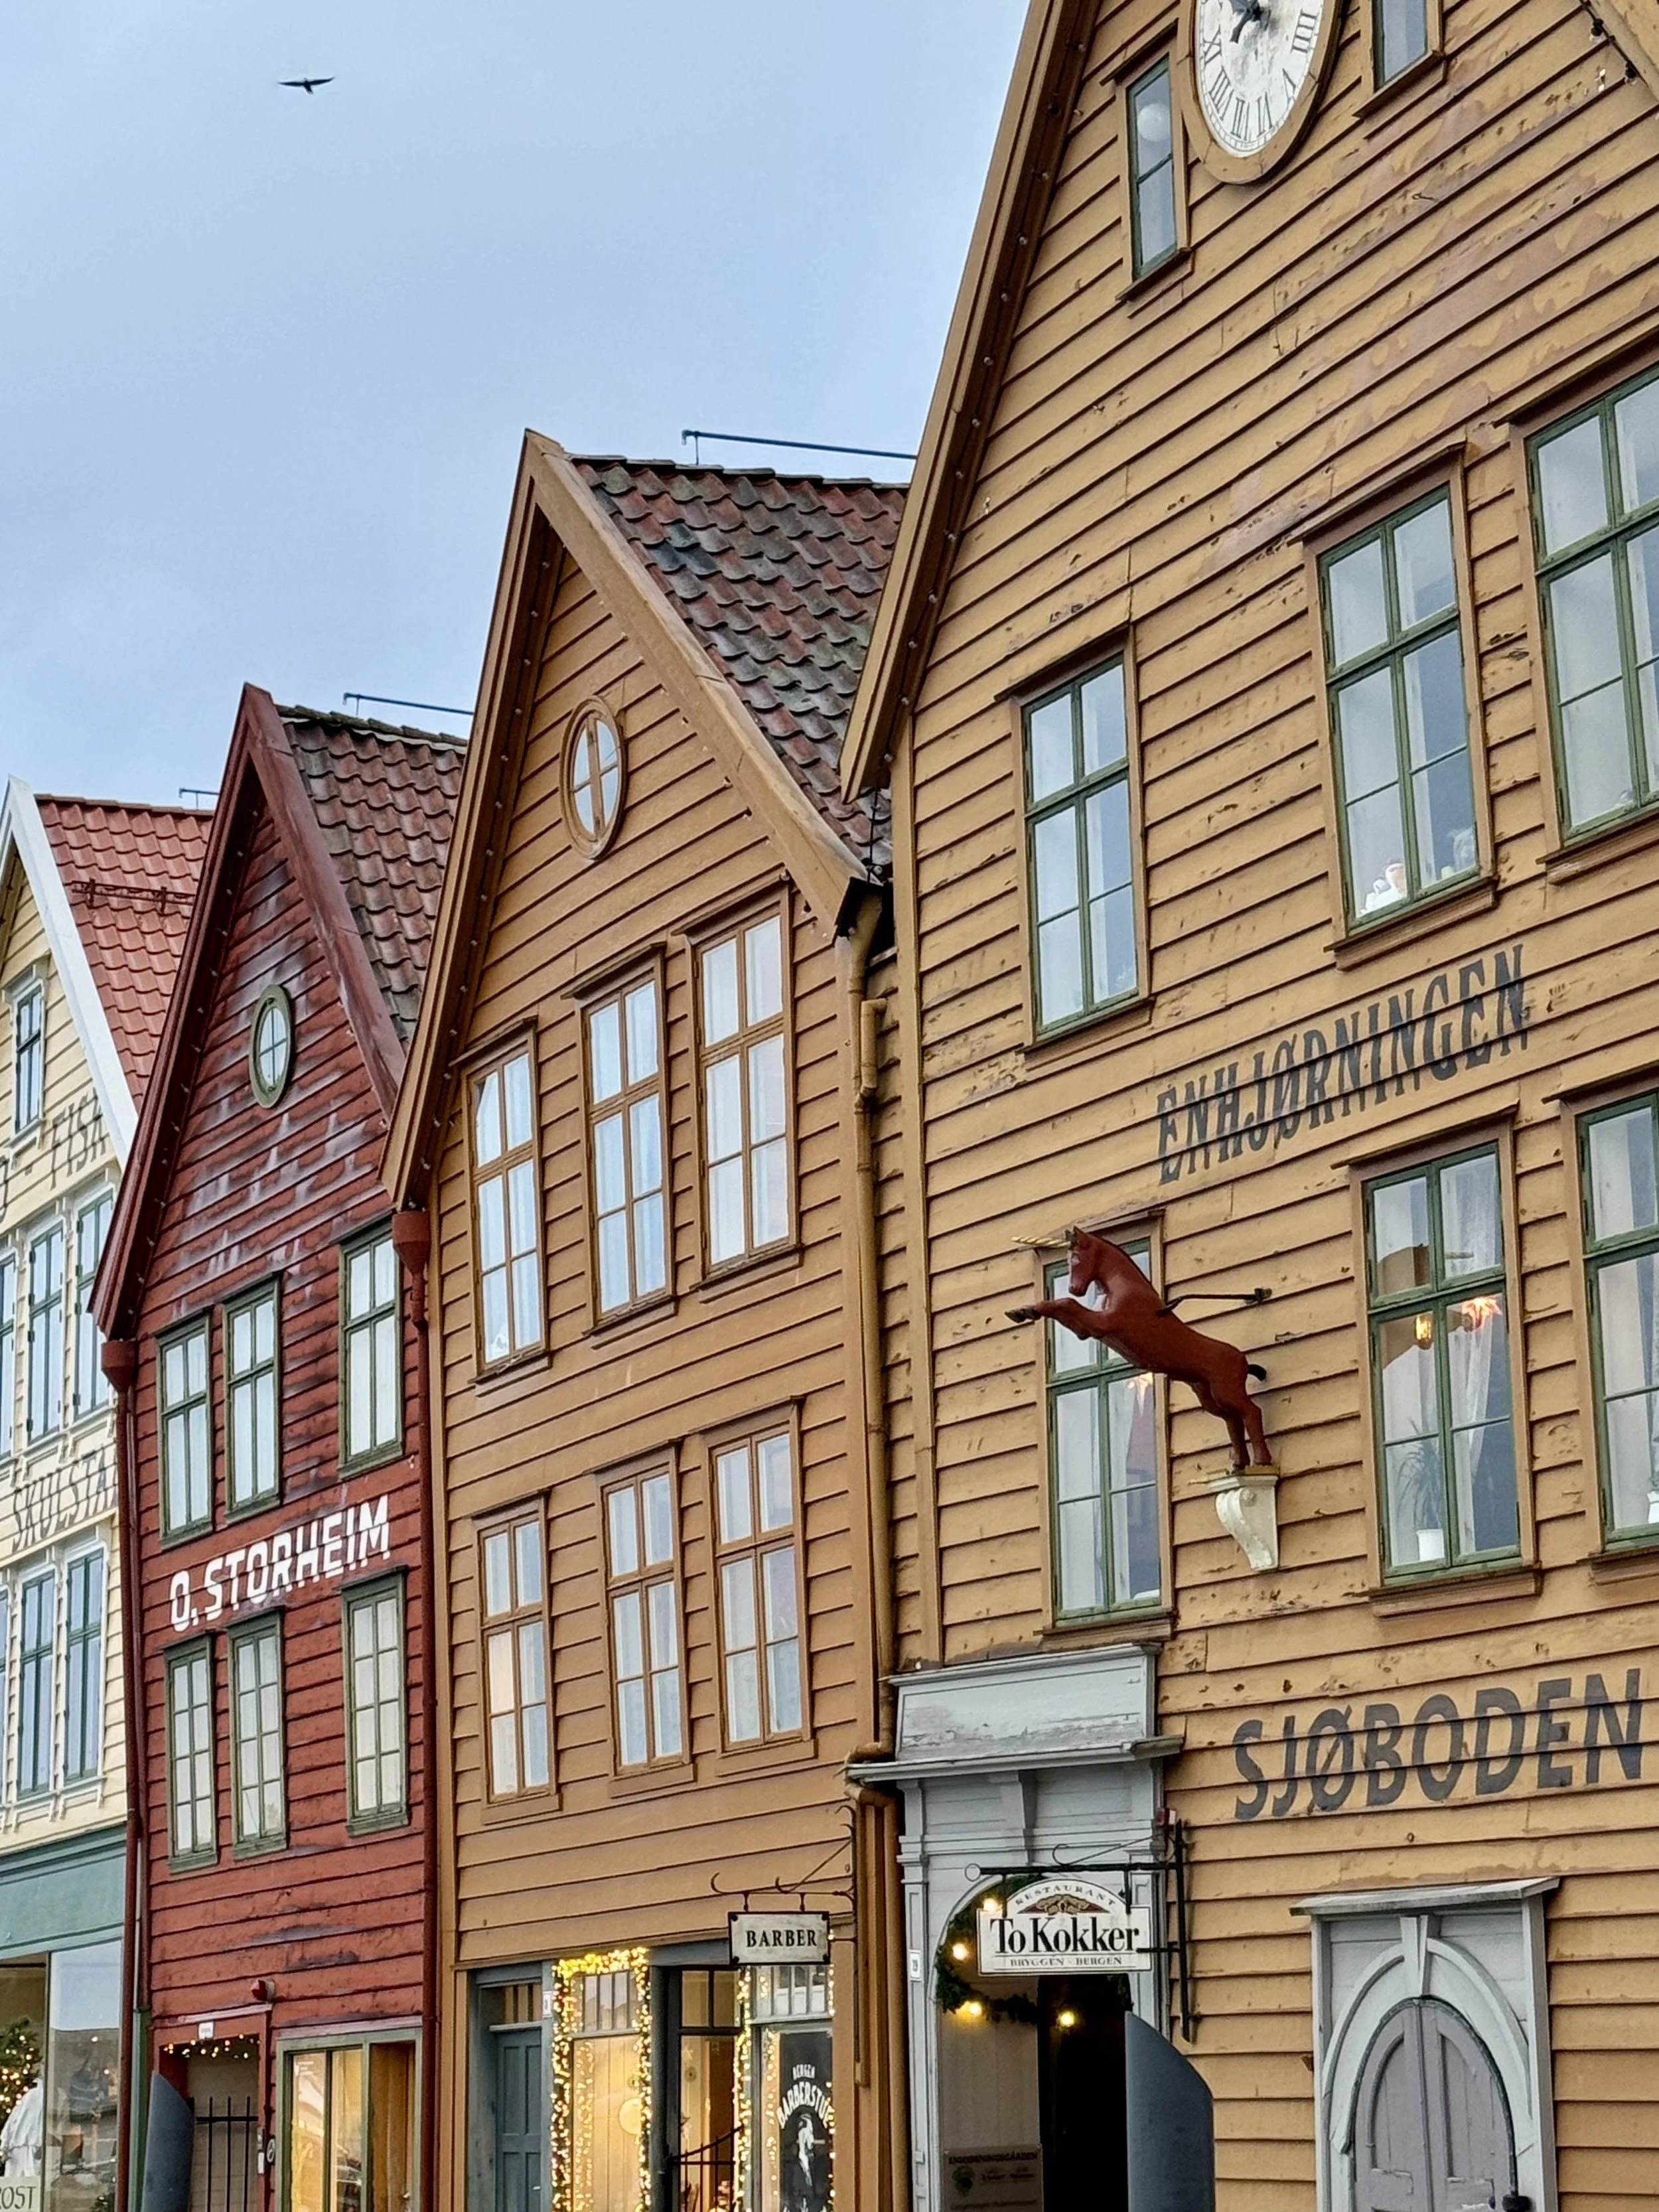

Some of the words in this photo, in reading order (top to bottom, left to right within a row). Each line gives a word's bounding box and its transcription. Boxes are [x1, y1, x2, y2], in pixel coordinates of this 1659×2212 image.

[1156, 944, 1528, 1185] ENHJØRNINGEN
[12, 1441, 118, 1554] SKULSTA
[1232, 1668, 1642, 1821] SJØBODEN
[1015, 1884, 1116, 1906] RESTAURANT
[746, 1929, 817, 1947] BARBER
[989, 1918, 1026, 1953] To
[1029, 1917, 1139, 1953] Kokker
[1010, 1958, 1064, 1966] BRYGGEN
[1076, 1956, 1122, 1965] BERGEN
[0, 2185, 37, 2210] OST
